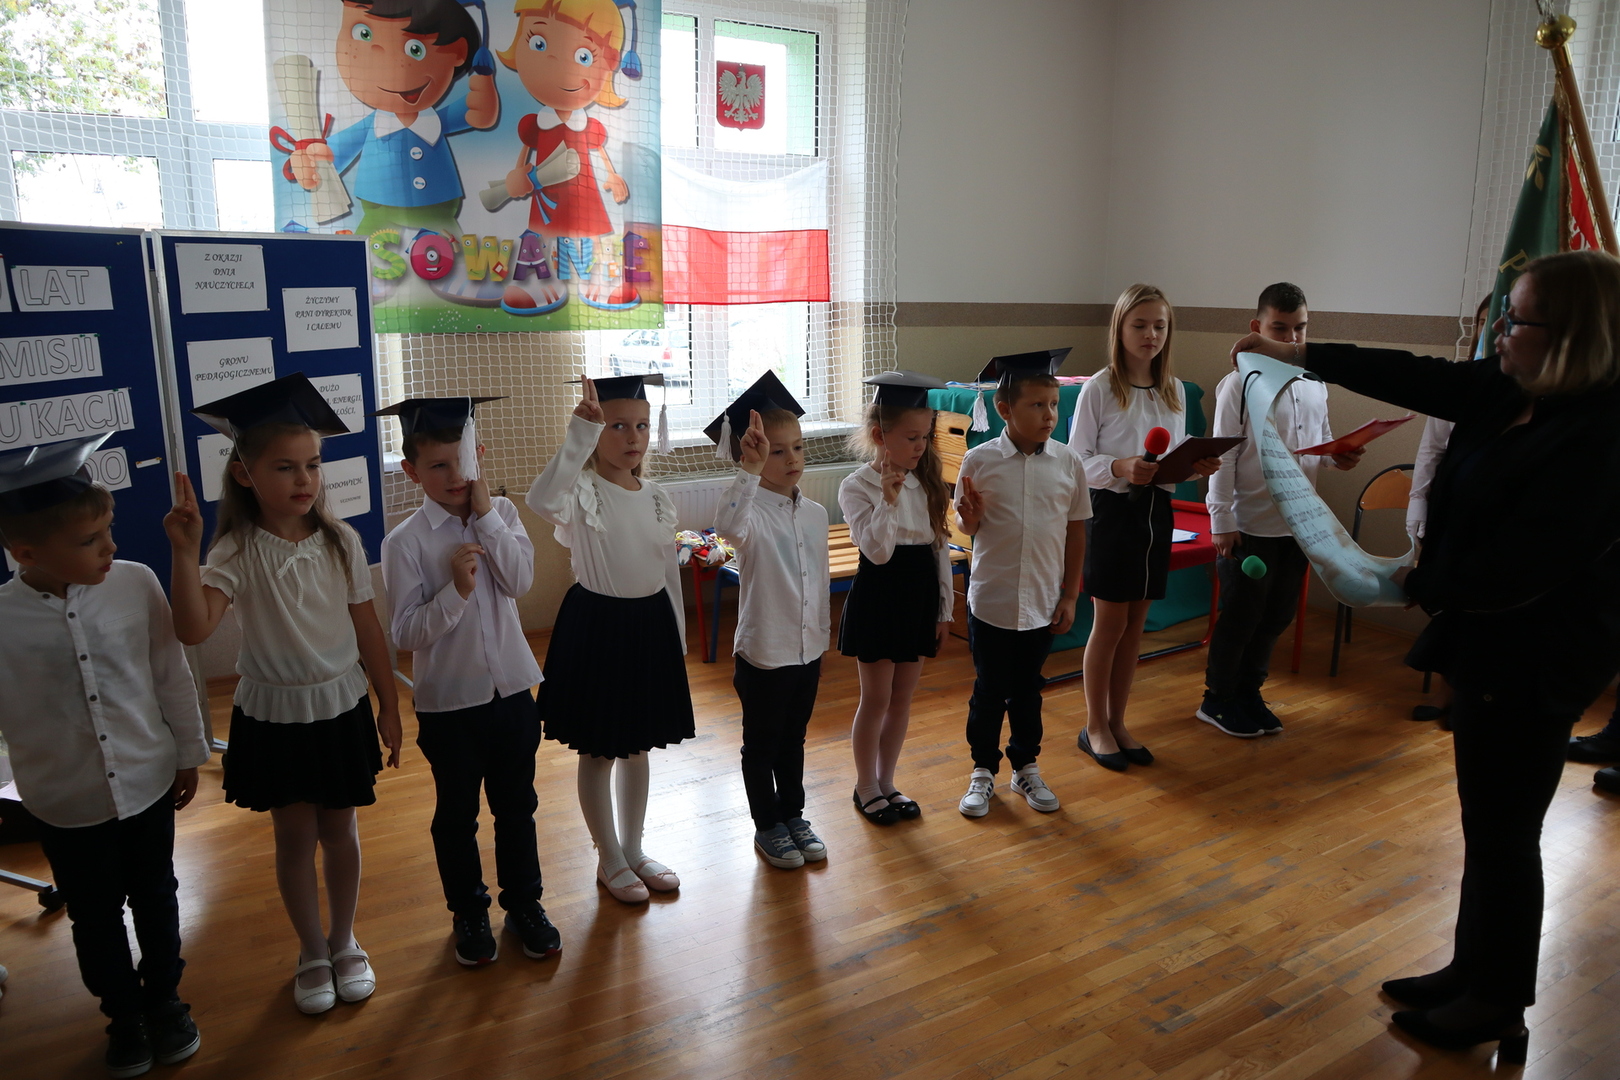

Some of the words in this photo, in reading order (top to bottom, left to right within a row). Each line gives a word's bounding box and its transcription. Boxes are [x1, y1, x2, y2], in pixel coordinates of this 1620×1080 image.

[204, 254, 211, 262] Z
[212, 254, 243, 263] OKAZJI
[213, 268, 236, 276] DNIA
[20, 269, 90, 306] LAT
[195, 281, 255, 290] NAUCZYCIELA
[305, 296, 340, 304] ŻYCZYMY
[295, 309, 314, 319] PANI
[315, 308, 353, 318] DYREKTOR
[219, 355, 249, 368] GRONU
[195, 366, 273, 381] PEDAGOGICZNEMU
[319, 384, 340, 393] DUŻO
